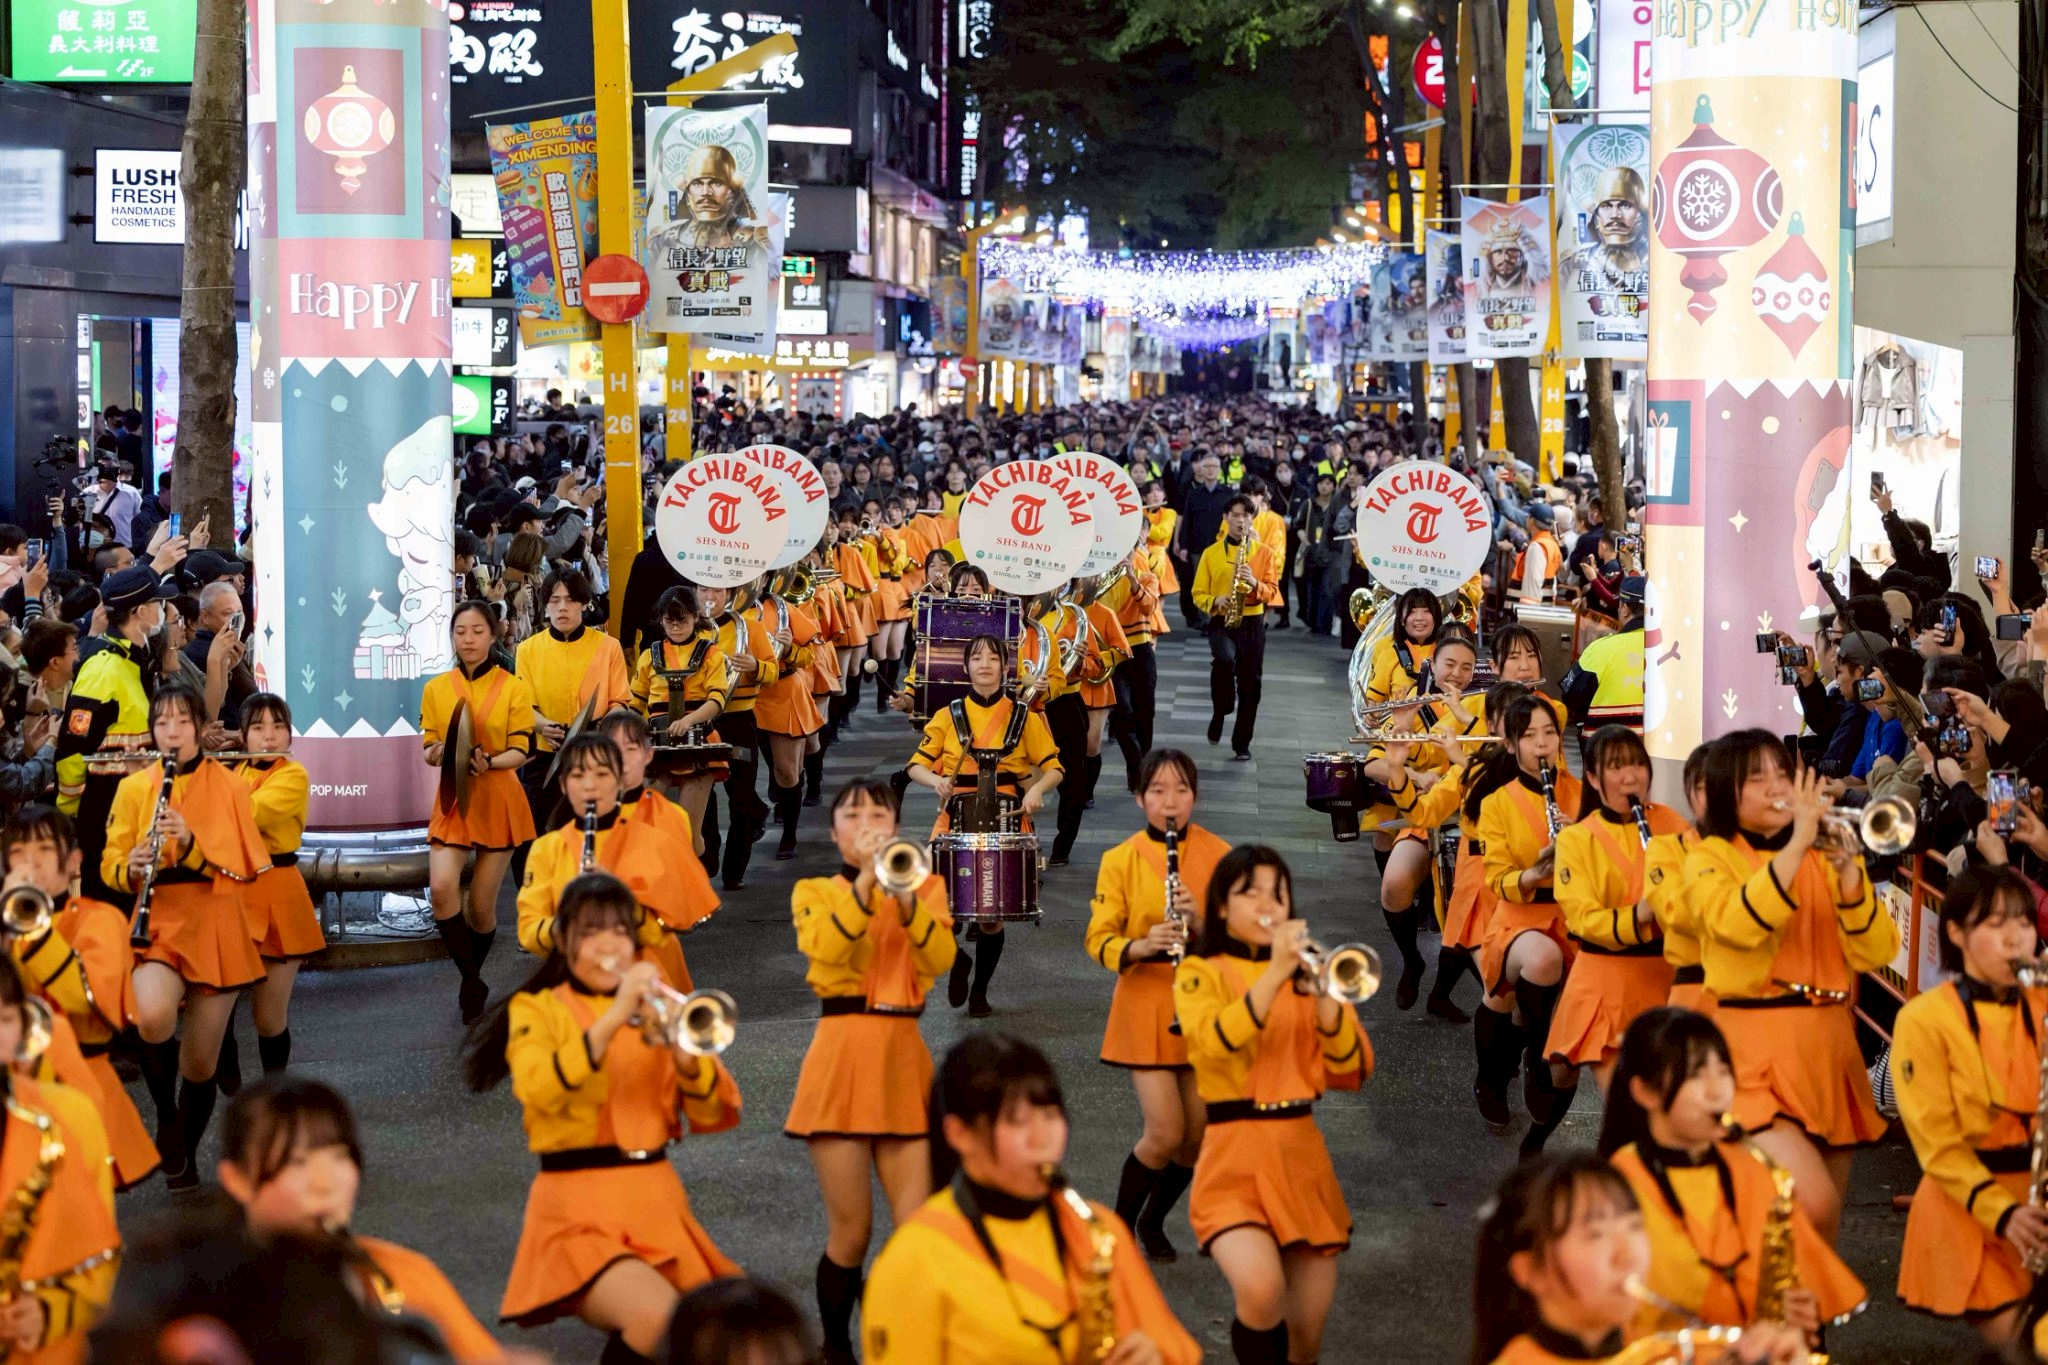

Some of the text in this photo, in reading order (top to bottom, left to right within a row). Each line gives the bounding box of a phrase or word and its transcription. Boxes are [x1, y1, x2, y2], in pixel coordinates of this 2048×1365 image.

[57, 8, 151, 32] 薩莉亞
[48, 34, 160, 54] 義大利料理
[139, 66, 155, 78] 2F
[504, 124, 594, 146] WELCOME TO
[507, 140, 597, 166] XIMENDING
[111, 168, 176, 186] LUSH
[111, 188, 176, 204] FRESH
[111, 206, 176, 216] HANDMADE
[111, 217, 176, 228] COSMETICS
[667, 247, 748, 269] 信長之野望
[687, 270, 730, 293] 真戰
[289, 273, 420, 330] Happy
[610, 372, 627, 393] H
[671, 378, 684, 393] H
[1546, 387, 1560, 403] H
[606, 415, 633, 435] 26
[667, 408, 688, 424] 24
[664, 459, 787, 523] TACHIBANA
[967, 461, 1092, 526] TACHIBANA
[1365, 469, 1488, 533] TACHIBANA
[696, 536, 750, 551] SHS BAND
[996, 537, 1052, 553] SHS BAND
[1391, 545, 1447, 560] SHS BAND
[310, 784, 368, 796] POP MART
[982, 869, 994, 908] YAMAHA
